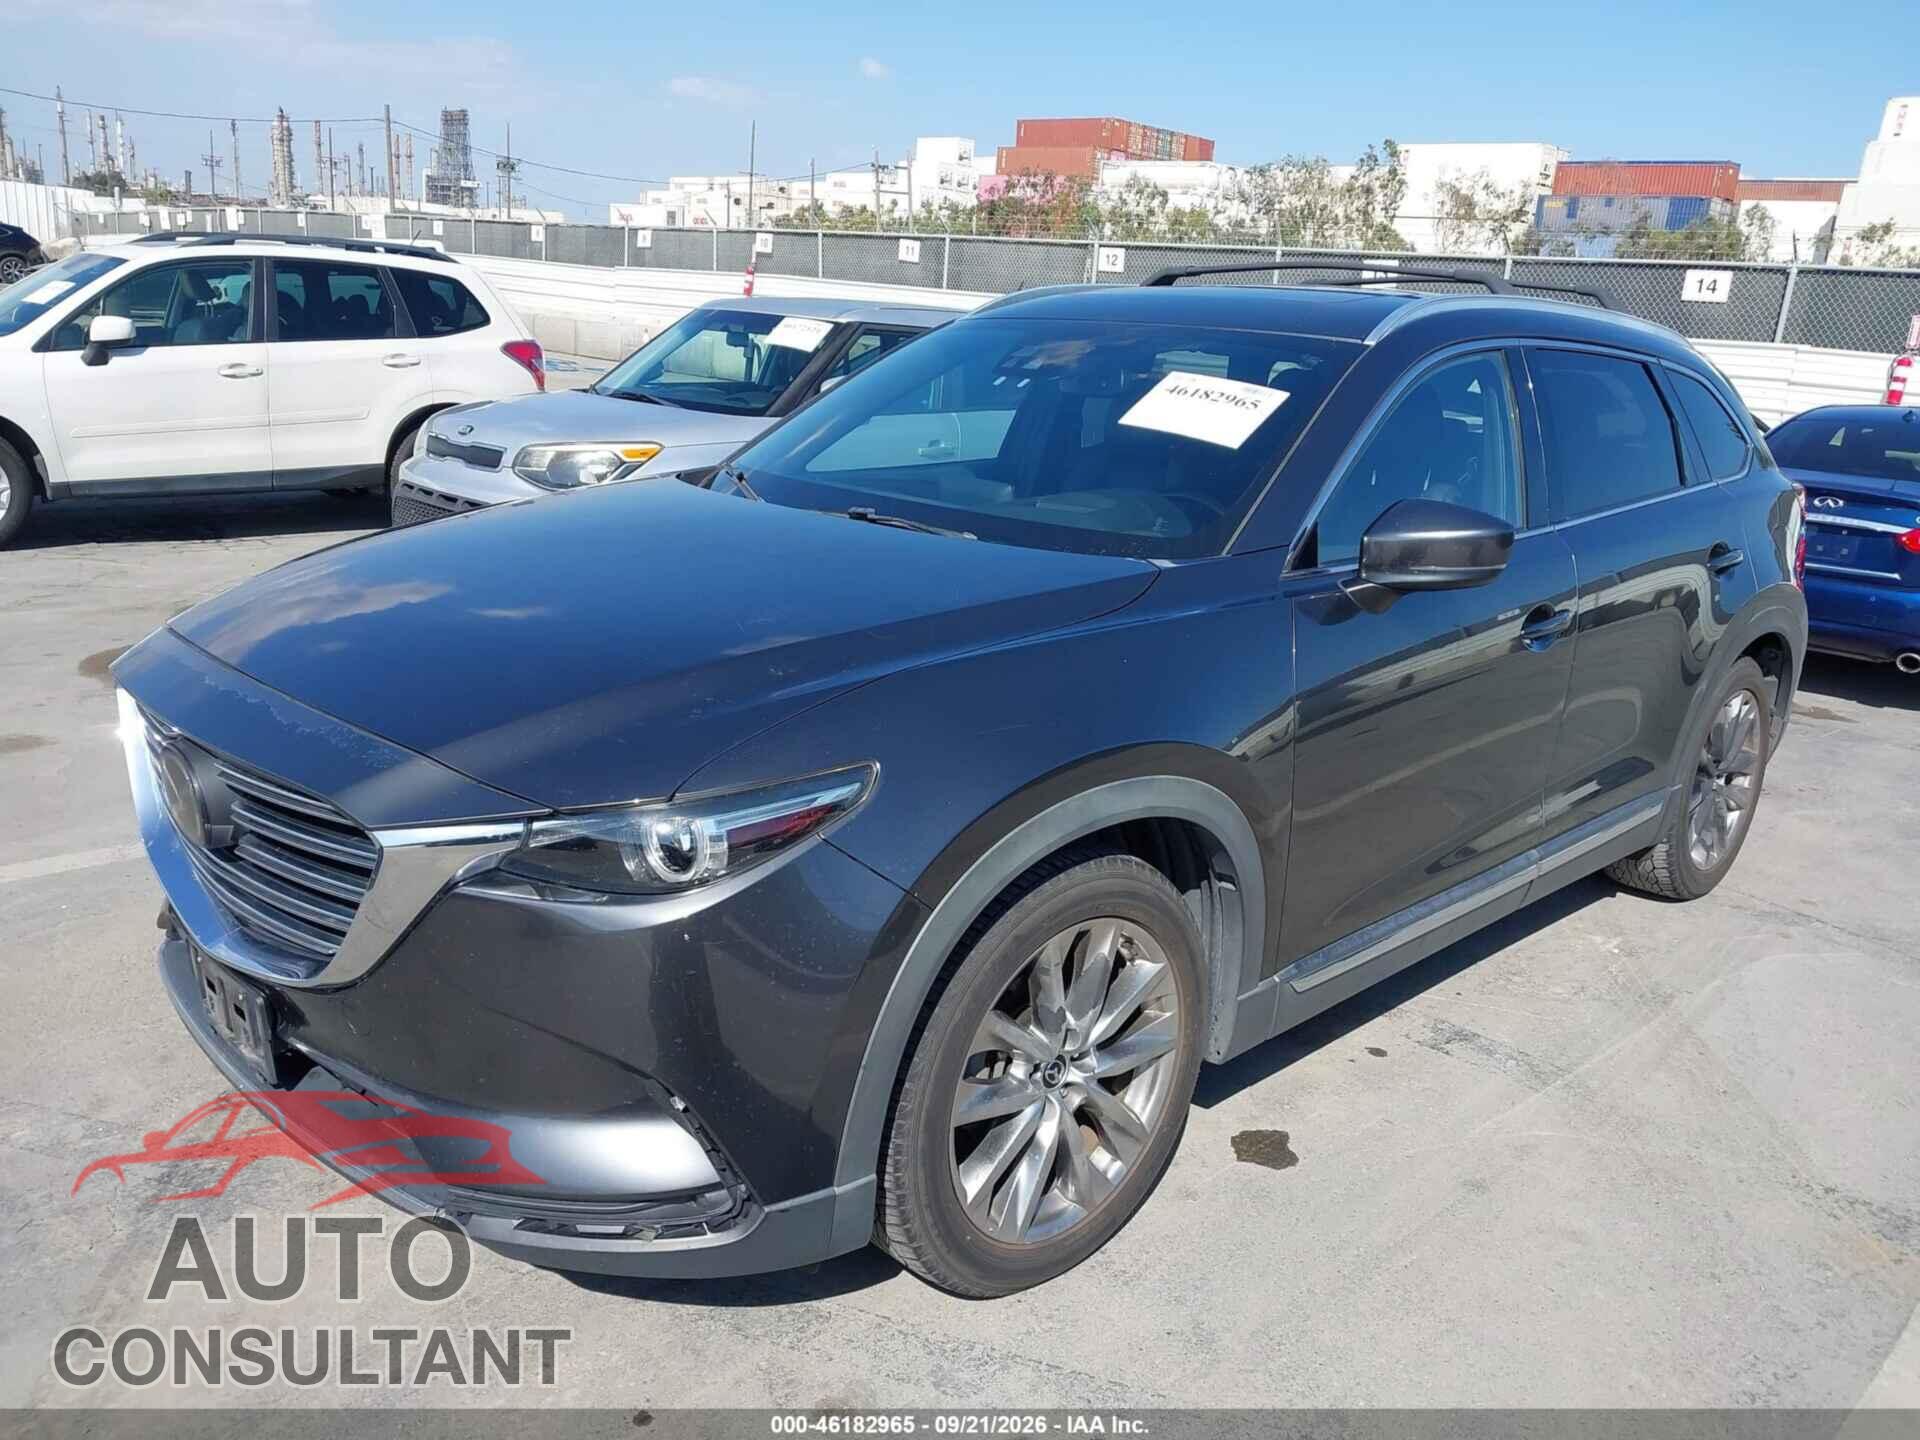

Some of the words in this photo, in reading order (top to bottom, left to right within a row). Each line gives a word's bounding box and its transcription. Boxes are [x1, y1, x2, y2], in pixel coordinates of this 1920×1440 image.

[1105, 254, 1118, 266] 12
[1696, 277, 1718, 294] 14
[1165, 384, 1262, 411] 46182965
